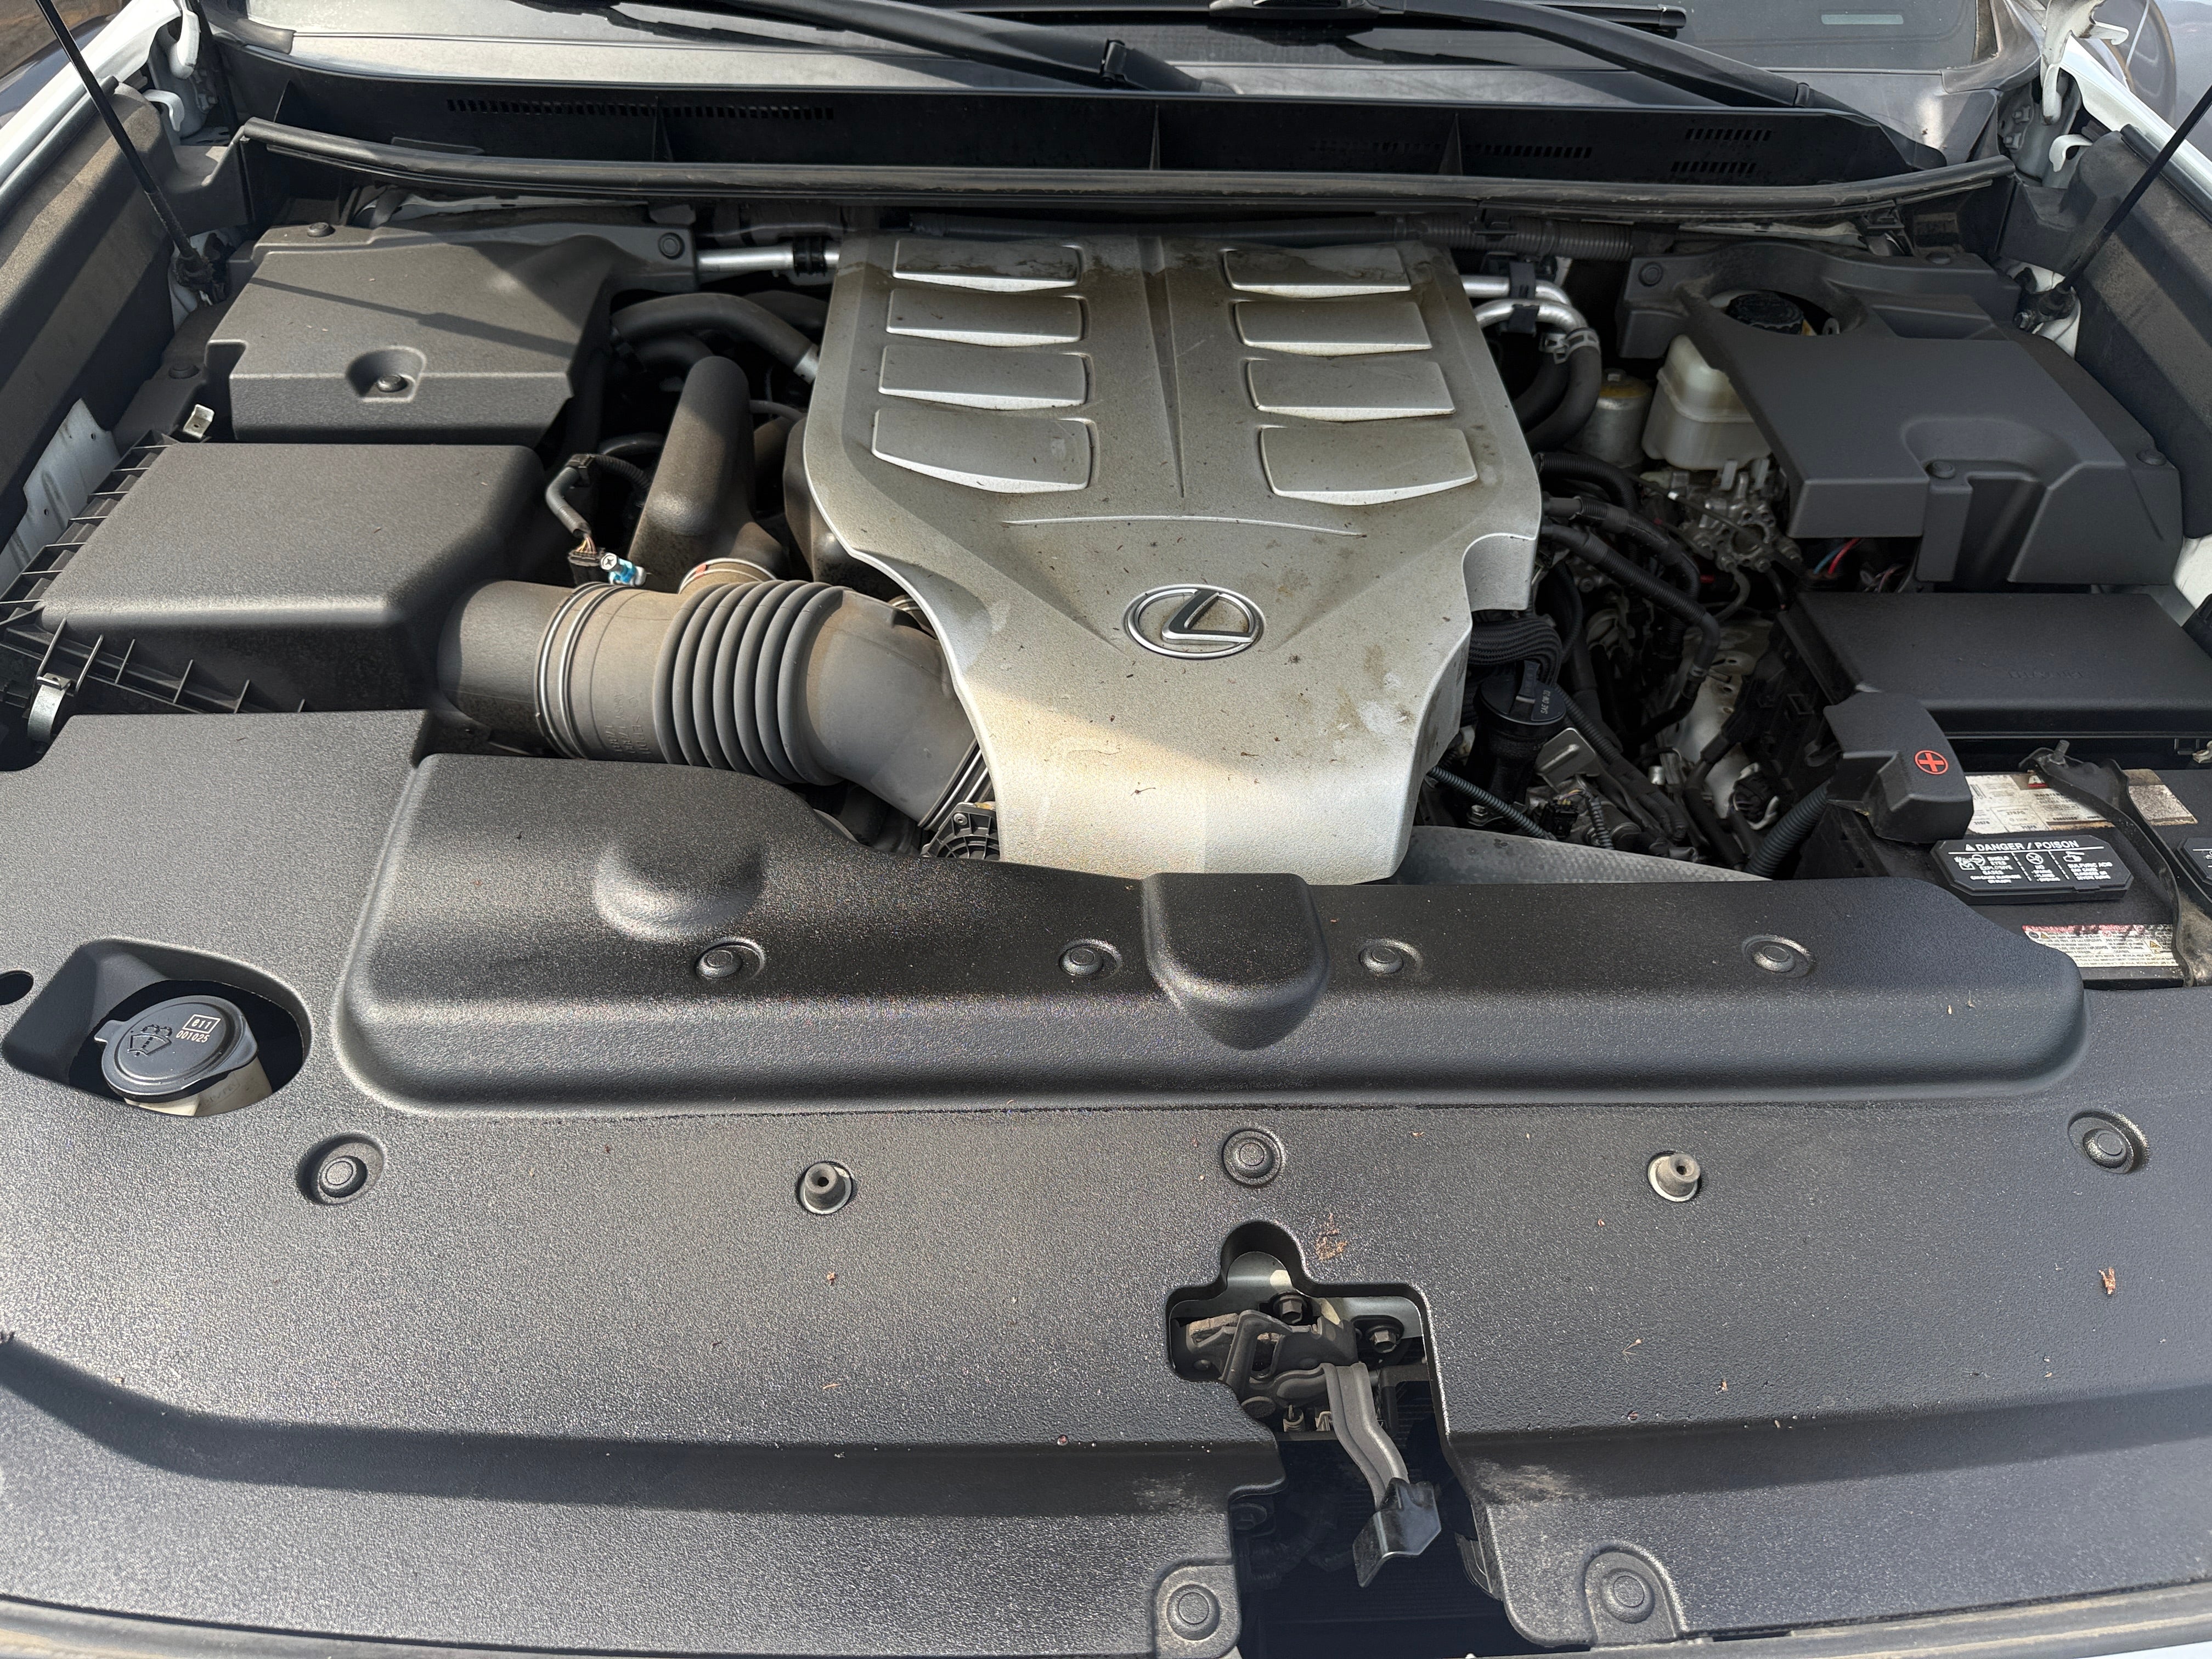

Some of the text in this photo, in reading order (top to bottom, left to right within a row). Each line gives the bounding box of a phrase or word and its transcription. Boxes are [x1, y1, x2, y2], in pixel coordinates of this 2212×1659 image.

[1540, 703, 1548, 715] SAE
[1975, 843, 2025, 851] DANGER
[2034, 840, 2079, 849] POISON
[191, 1019, 212, 1029] e11
[176, 1030, 211, 1043] 001025
